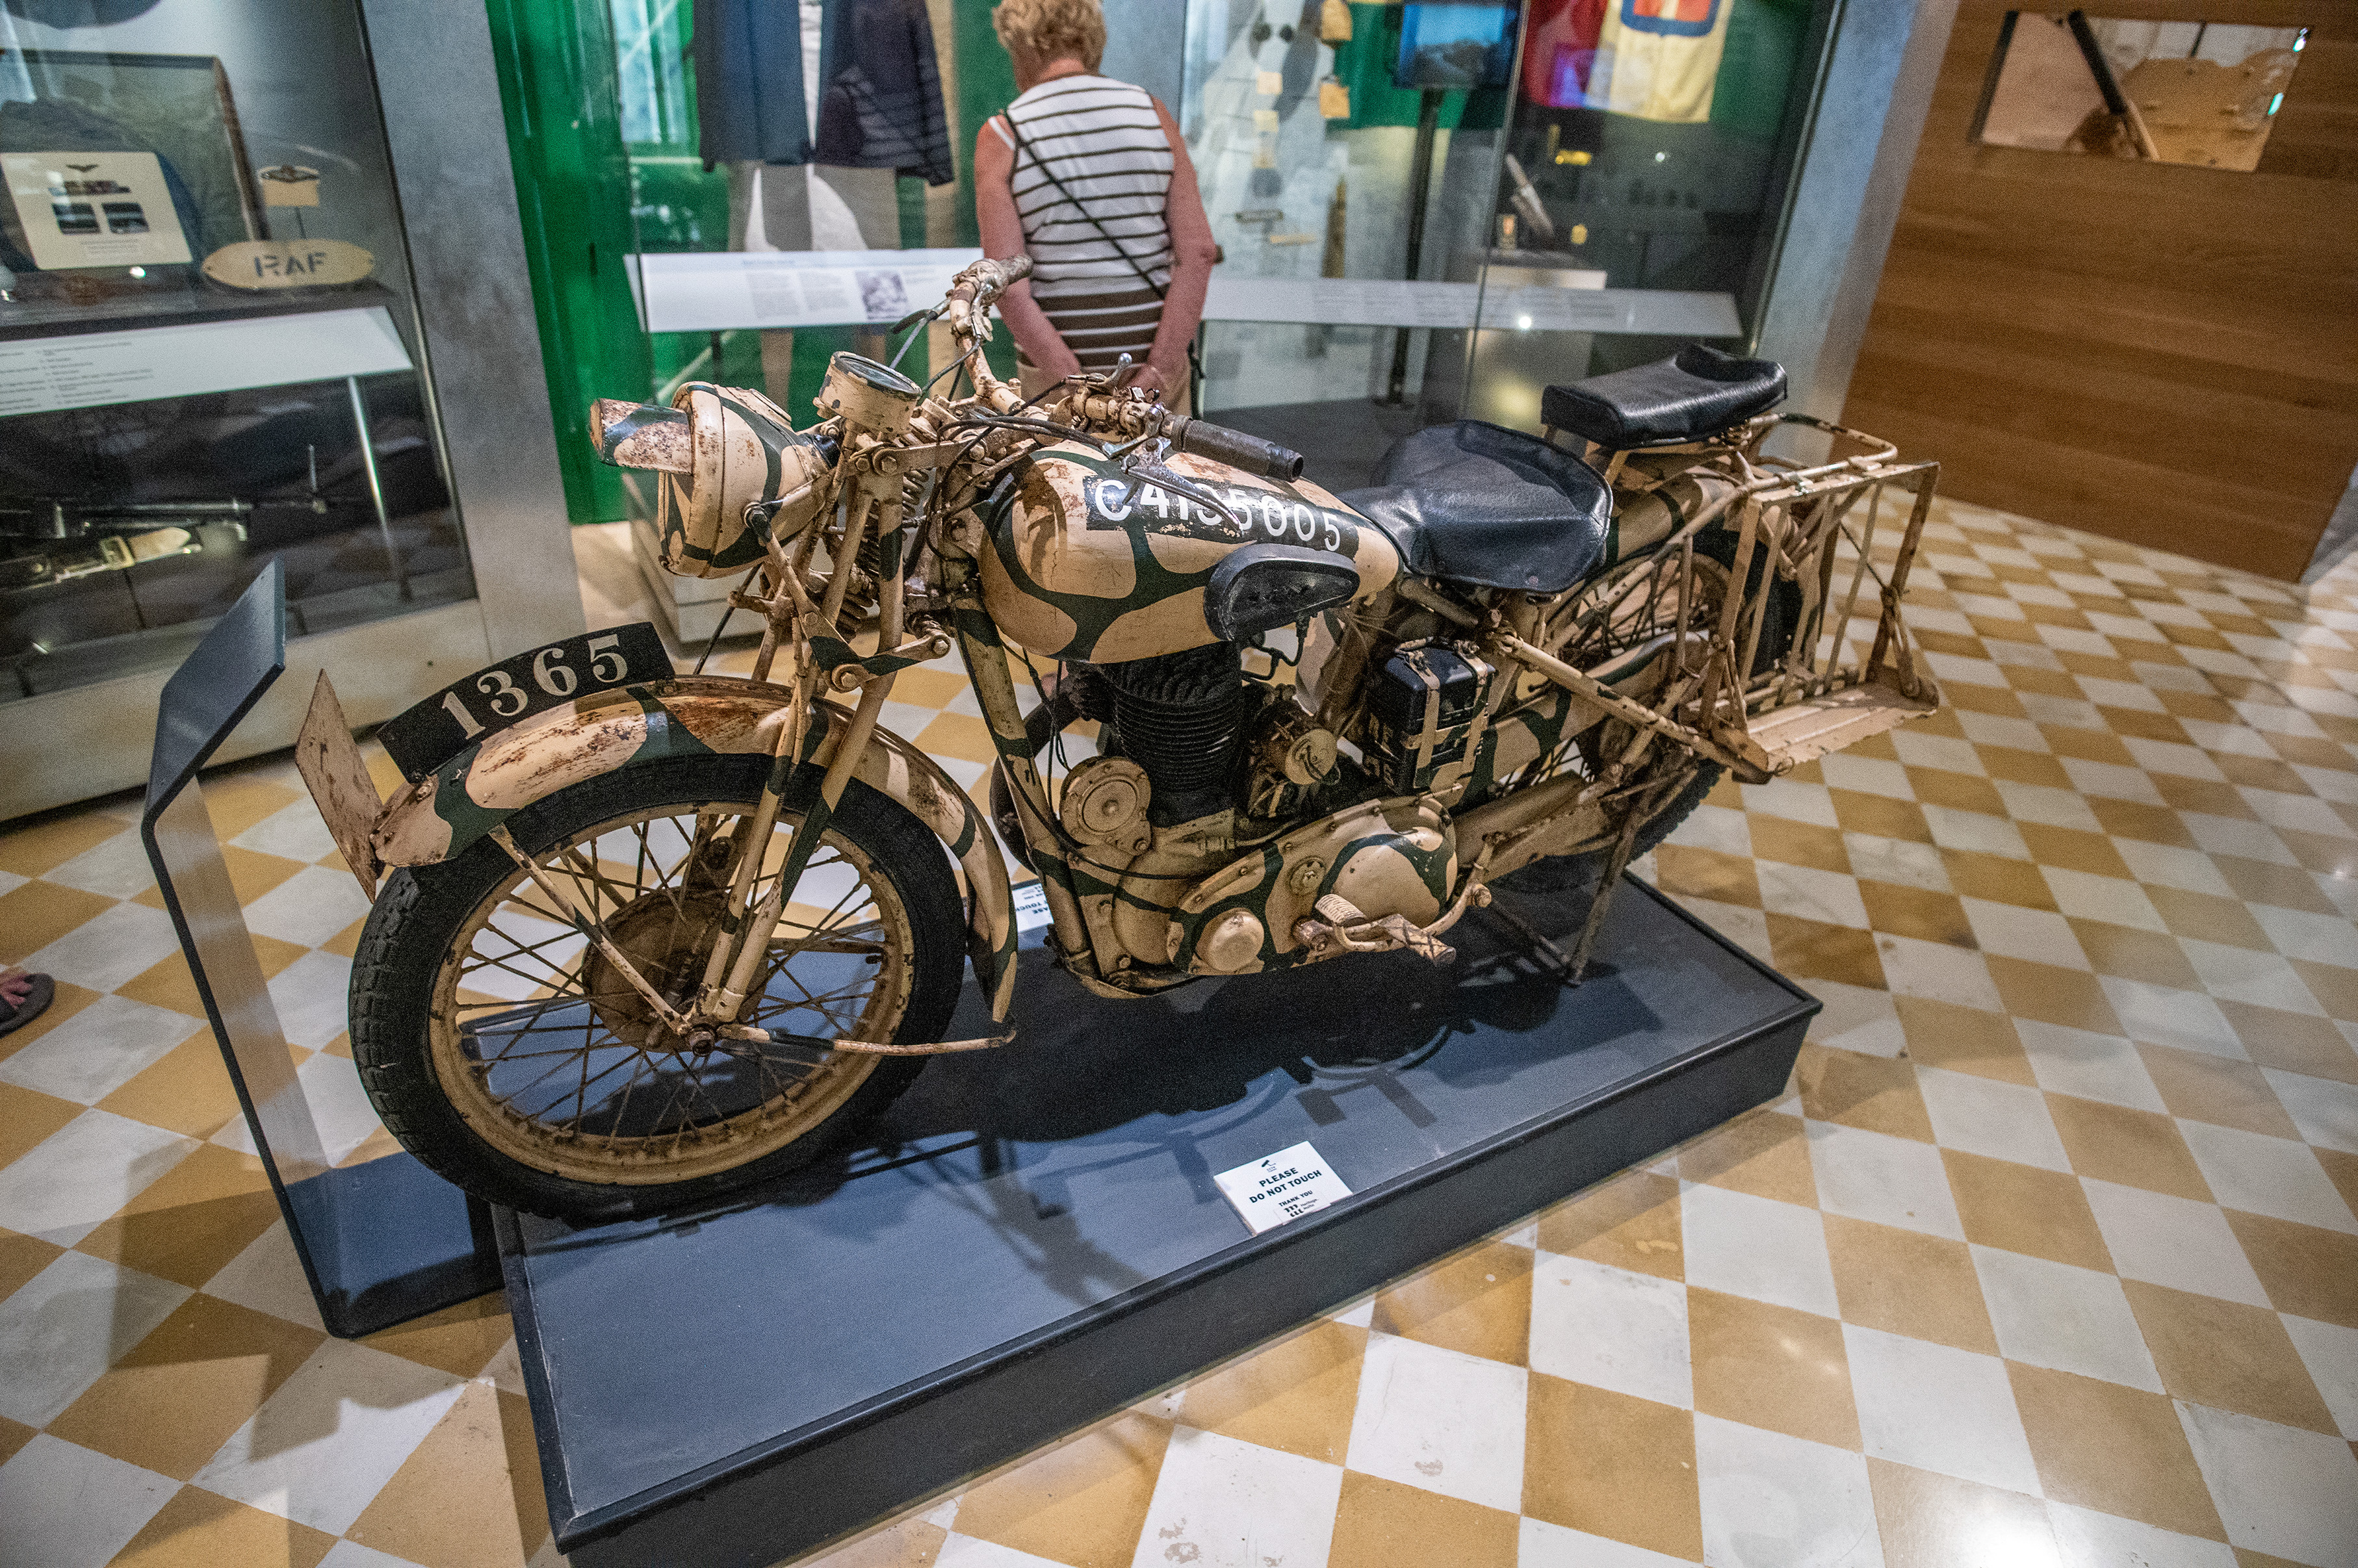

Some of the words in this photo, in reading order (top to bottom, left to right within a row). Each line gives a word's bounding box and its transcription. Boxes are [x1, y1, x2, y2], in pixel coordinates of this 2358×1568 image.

[254, 251, 326, 278] RAF
[442, 634, 628, 739] 1365
[1249, 1193, 1265, 1203] DO
[1266, 1184, 1287, 1196] NOT
[1288, 1170, 1322, 1187] TOUCH
[1259, 1168, 1299, 1187] PLEASE
[1278, 1196, 1300, 1207] THANK
